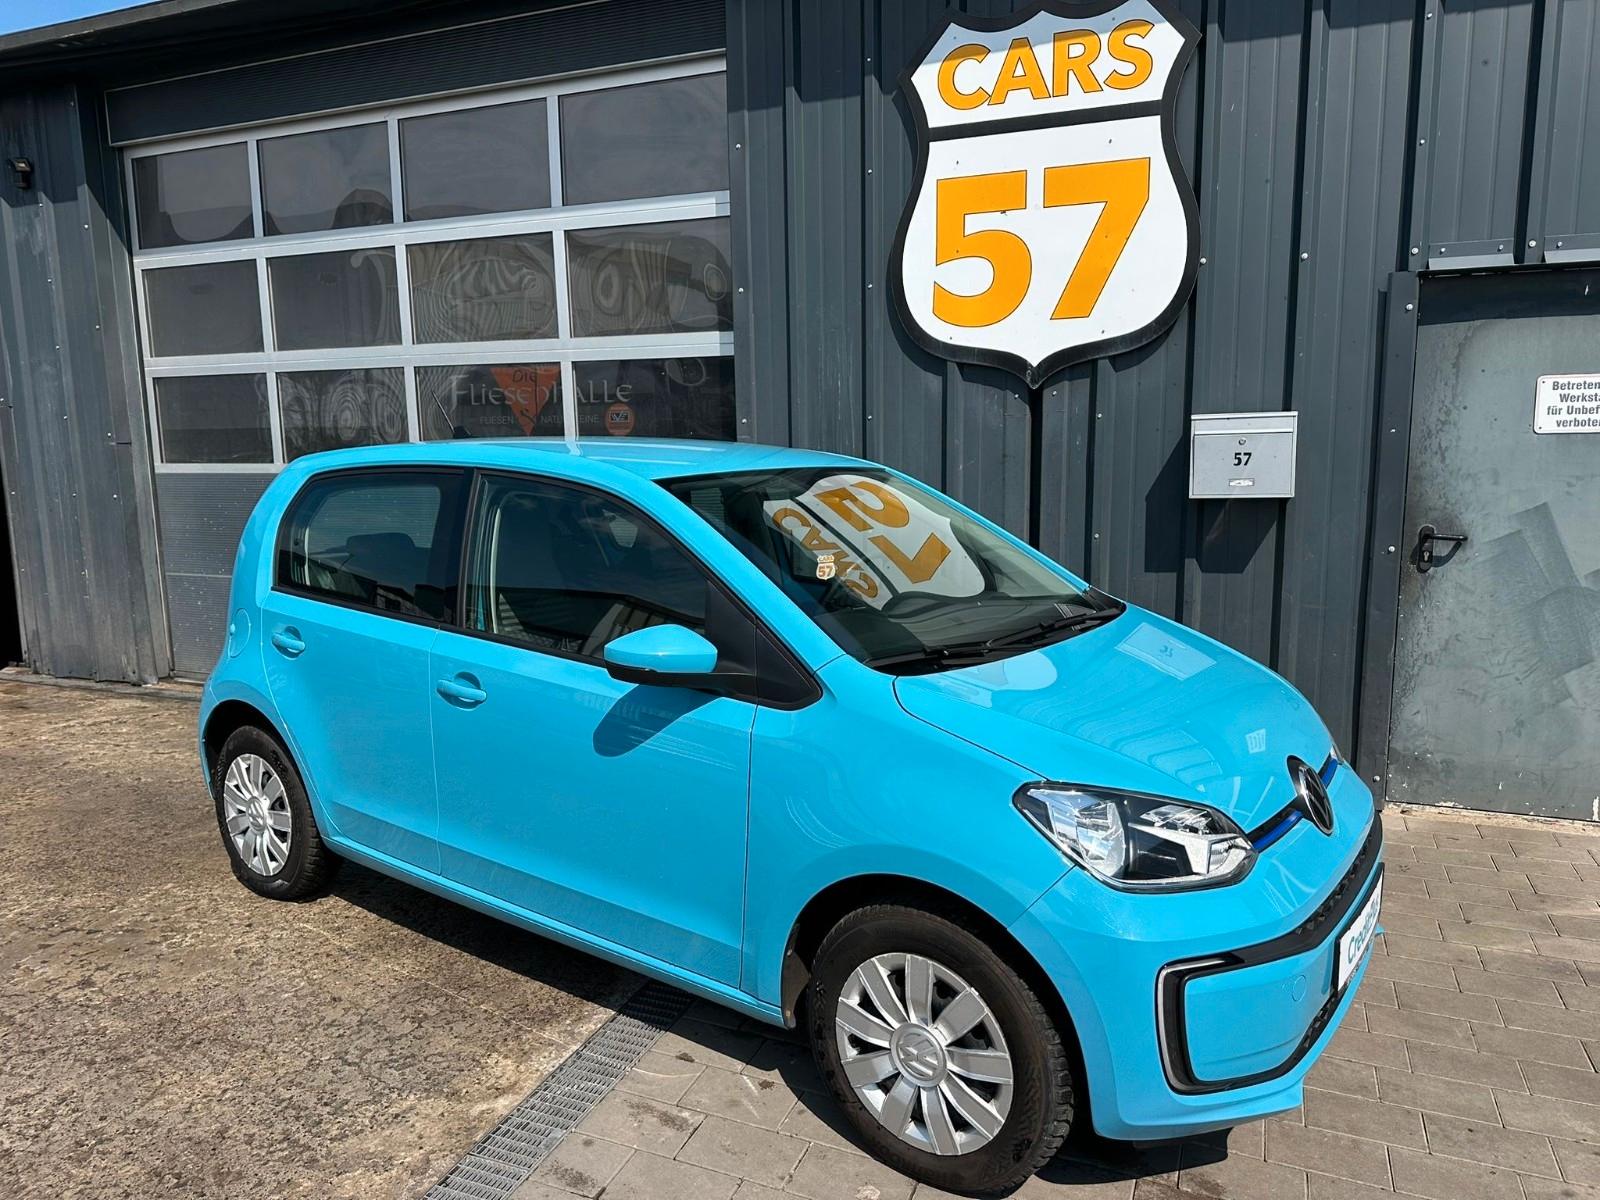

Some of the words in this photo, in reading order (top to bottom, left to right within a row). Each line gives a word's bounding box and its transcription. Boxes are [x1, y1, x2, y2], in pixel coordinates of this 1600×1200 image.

[938, 19, 1155, 110] CARS
[932, 157, 1151, 328] 57
[1552, 381, 1600, 391] Betreten
[1559, 393, 1600, 403] Werkst
[1547, 405, 1563, 415] für
[1556, 417, 1600, 427] verbote
[1233, 452, 1252, 466] 57
[818, 565, 833, 577] 57
